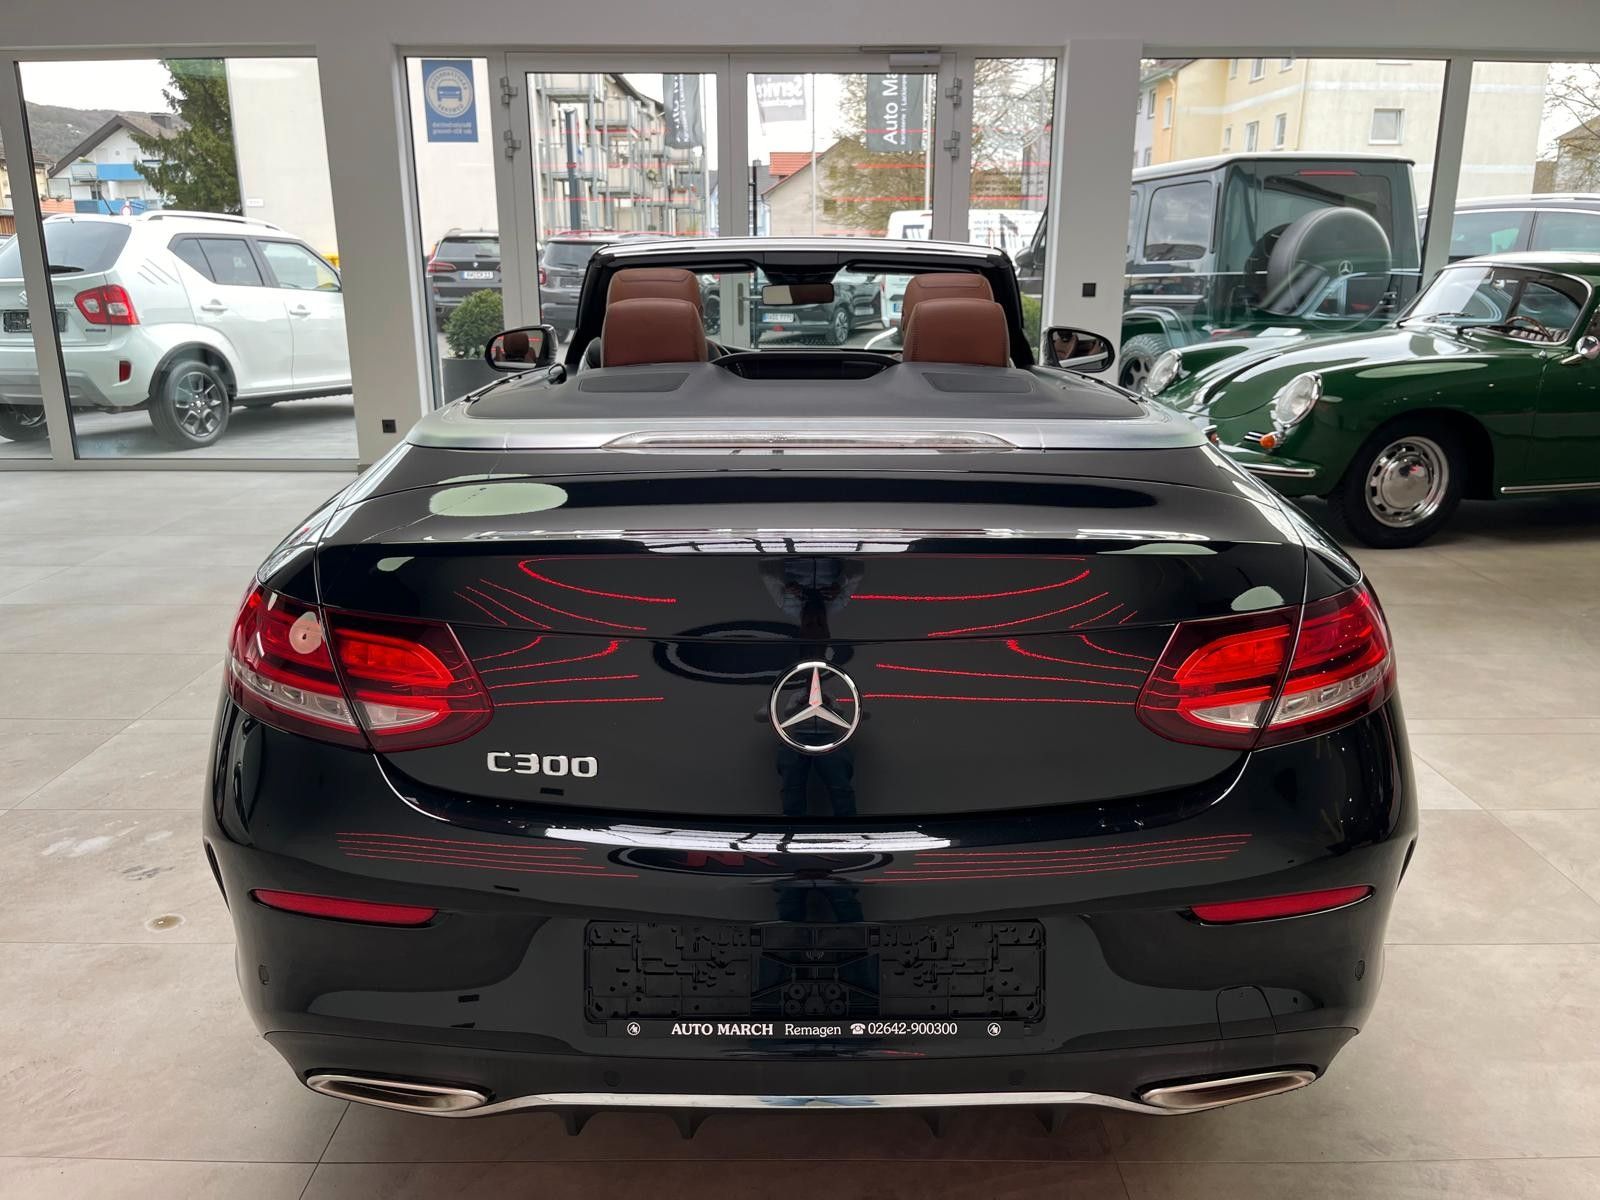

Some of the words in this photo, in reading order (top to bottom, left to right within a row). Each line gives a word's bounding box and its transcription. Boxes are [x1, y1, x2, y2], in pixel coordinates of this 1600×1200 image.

[883, 102, 899, 145] Auto
[486, 751, 598, 778] C300
[671, 1022, 714, 1036] AUTO
[717, 1022, 774, 1036] MARCH
[784, 1023, 842, 1038] Remagen
[867, 1021, 958, 1036] 02642-900300
